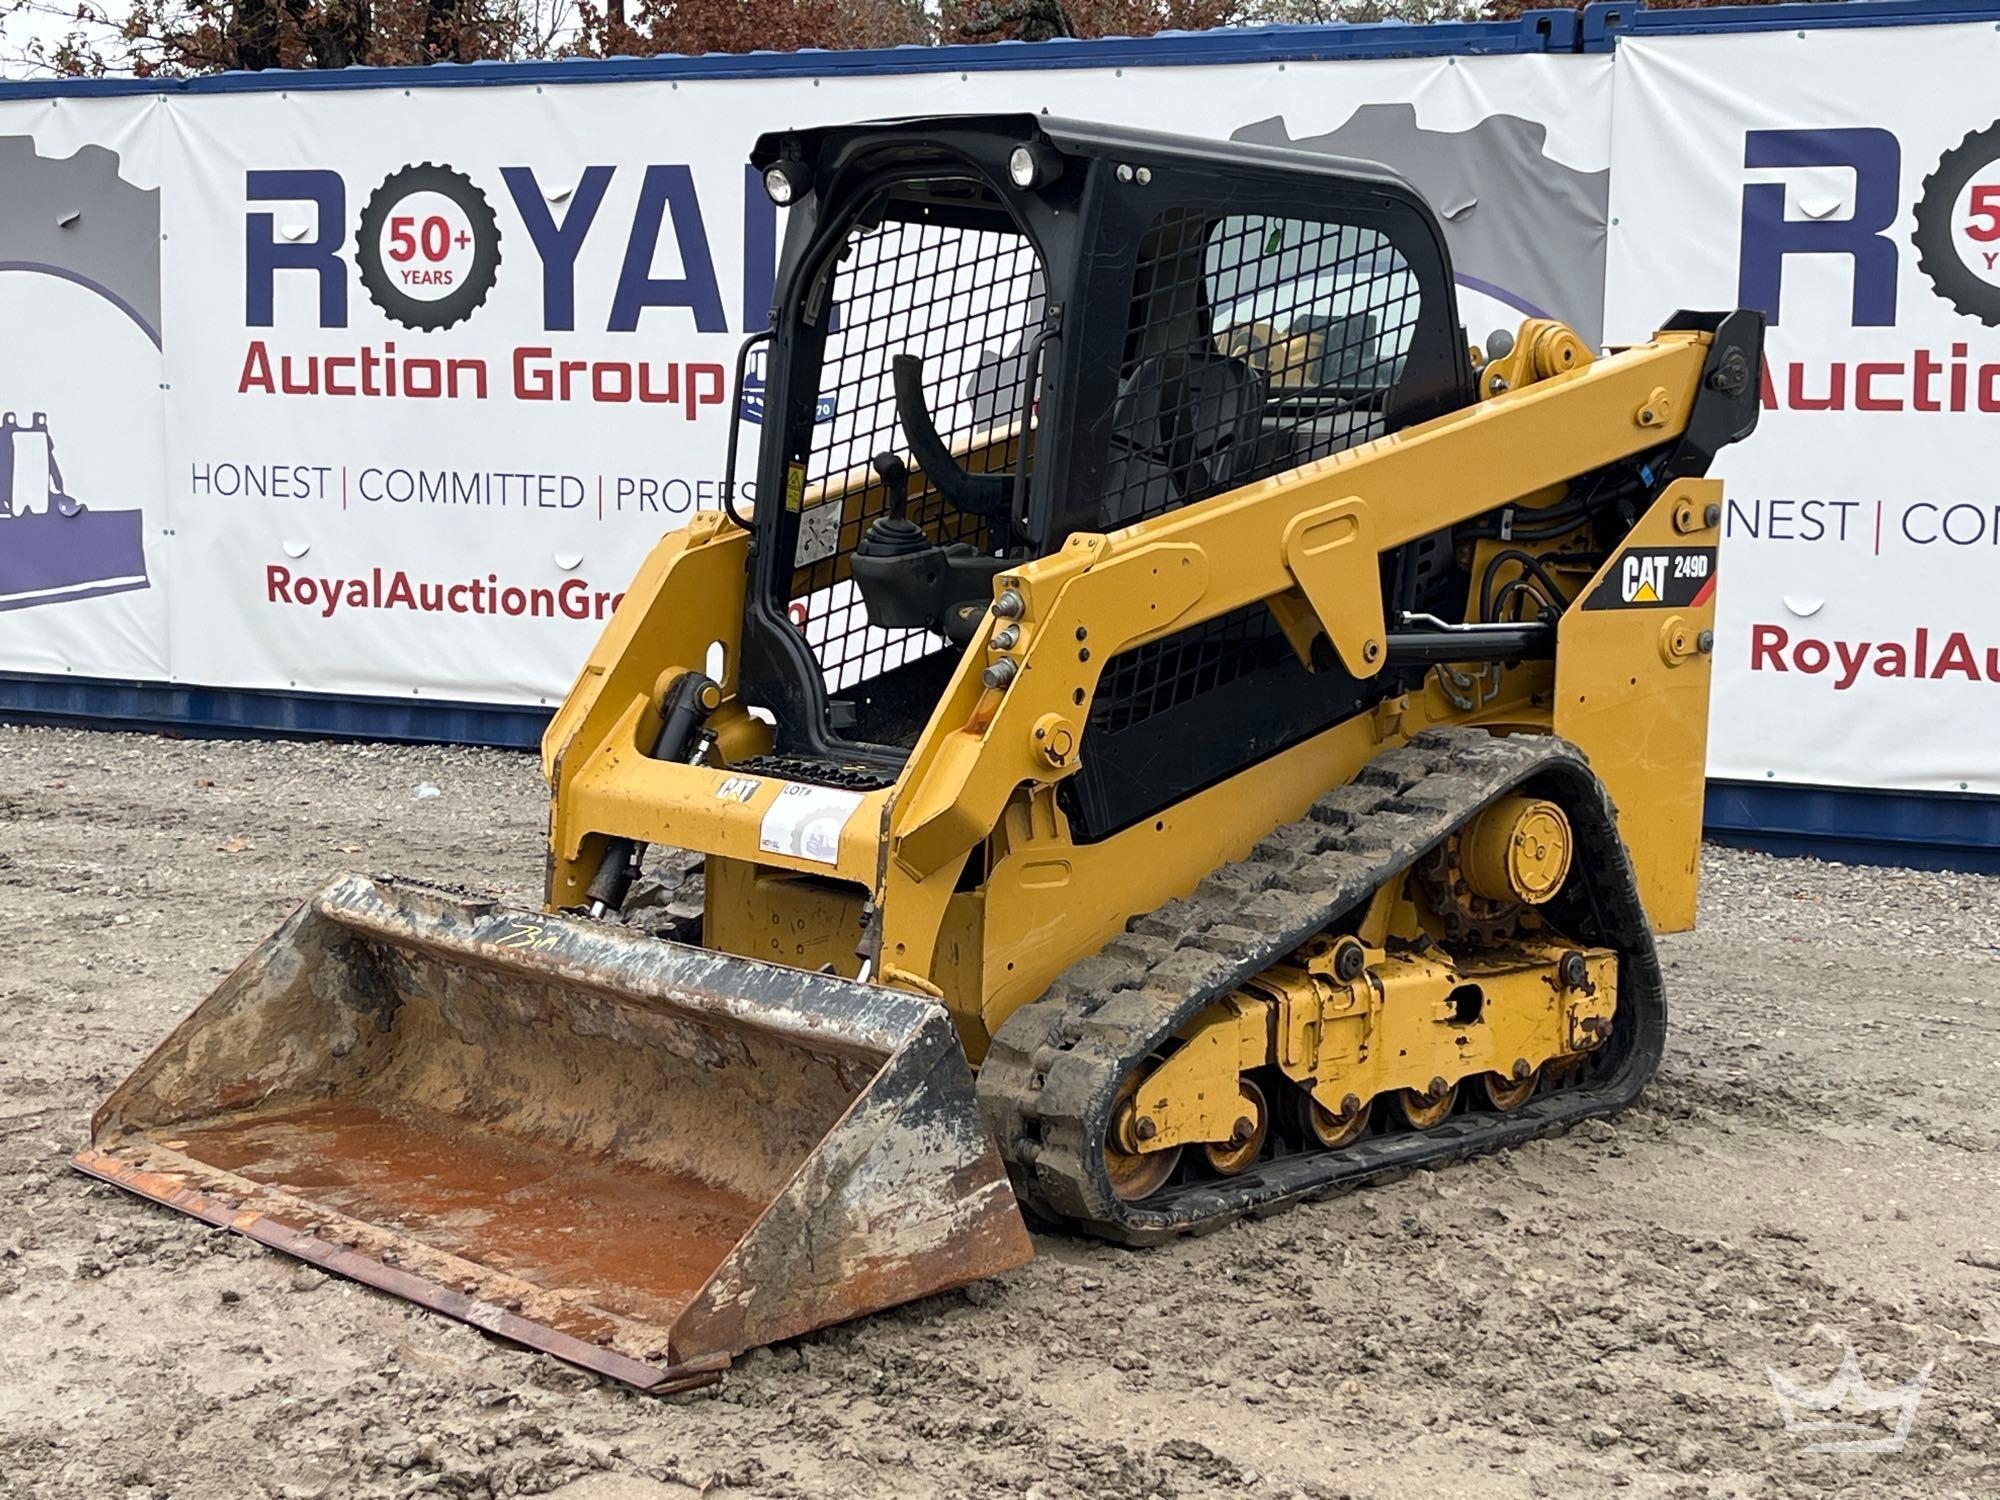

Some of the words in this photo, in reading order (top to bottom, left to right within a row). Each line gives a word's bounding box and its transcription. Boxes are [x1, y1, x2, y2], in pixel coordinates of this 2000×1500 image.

[388, 215, 471, 263] 50+
[401, 269, 453, 286] YEARS
[238, 341, 488, 400] Auction
[513, 347, 725, 420] Group
[192, 463, 332, 499] HONEST
[359, 468, 585, 509] COMMITTED
[1622, 556, 1669, 603] CAT
[1673, 555, 1708, 579] 249D
[716, 777, 762, 803] CAT
[783, 782, 812, 796] LOT#
